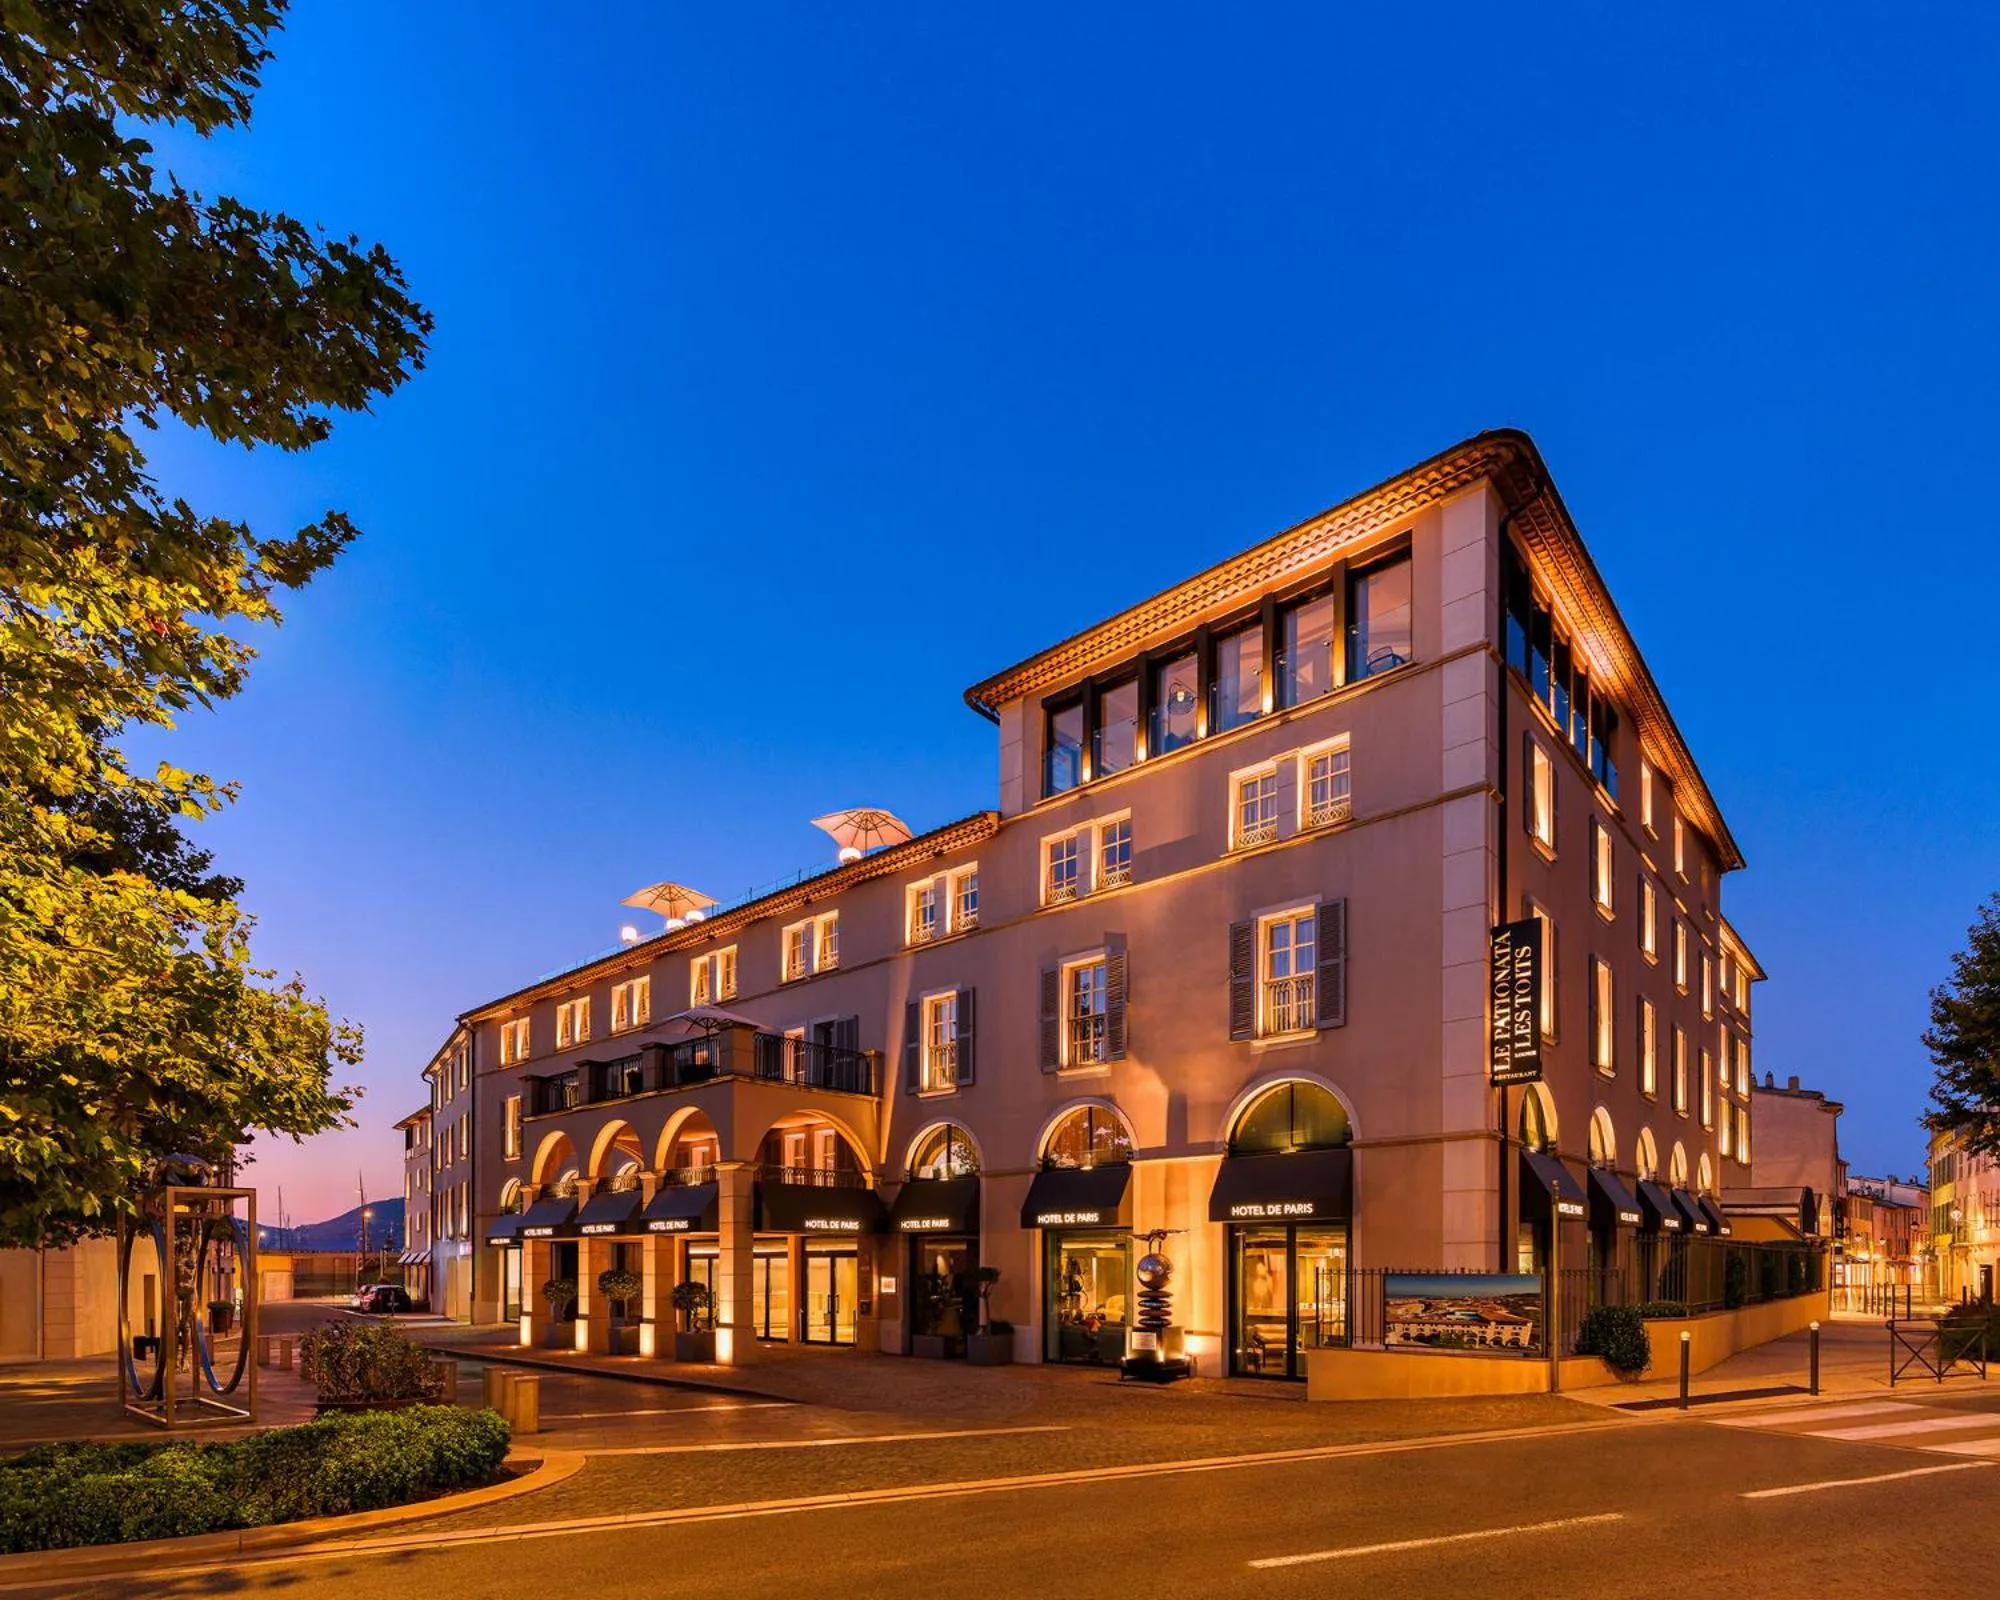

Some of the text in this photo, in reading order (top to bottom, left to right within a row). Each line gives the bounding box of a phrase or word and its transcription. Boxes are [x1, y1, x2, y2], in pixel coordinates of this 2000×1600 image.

[1514, 946, 1532, 1008] TOITS
[1494, 930, 1511, 1072] LE PATIONATA
[1514, 1010, 1531, 1049] LES
[1231, 1203, 1313, 1216] HOTEL DE PARIS
[805, 1219, 860, 1230] HOTEL DE PARIS
[900, 1218, 949, 1229] HOTEL DE PARIS
[1037, 1212, 1099, 1224] HOTEL DE PARIS
